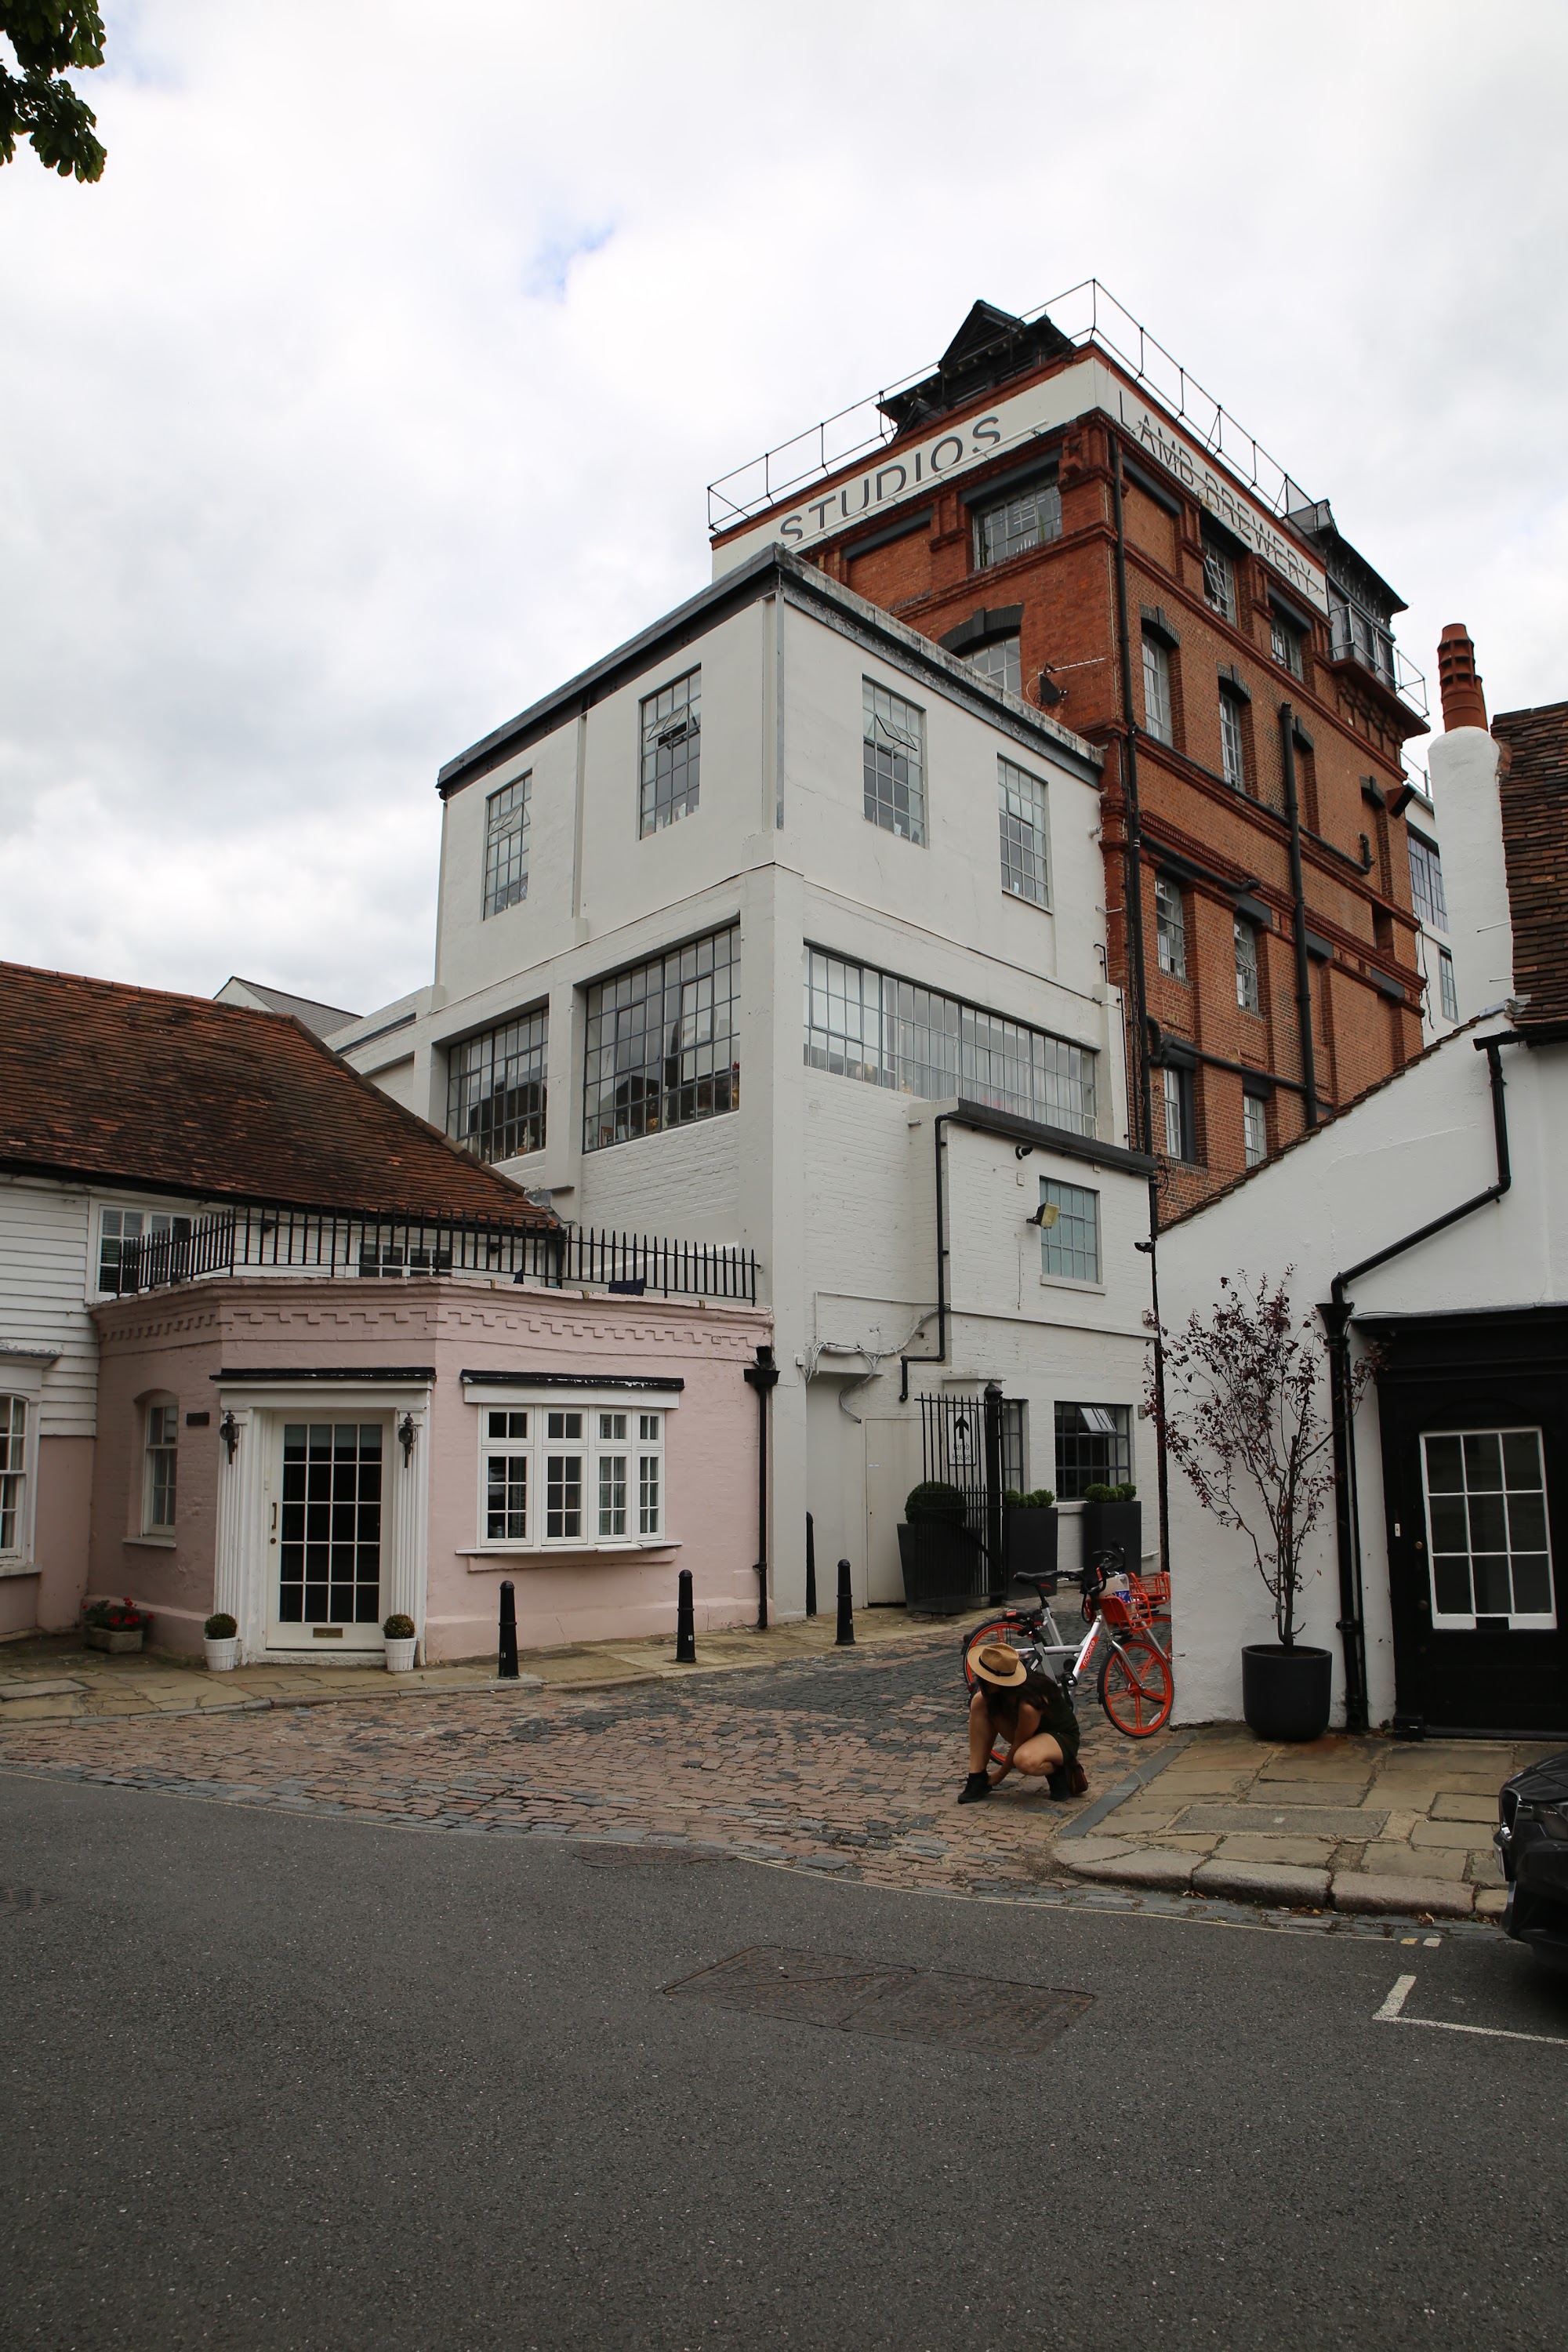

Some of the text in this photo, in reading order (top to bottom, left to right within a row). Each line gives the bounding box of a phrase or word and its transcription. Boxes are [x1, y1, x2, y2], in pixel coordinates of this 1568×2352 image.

[779, 416, 1001, 545] STUDIOS
[1119, 390, 1311, 593] LAMB BREWERY
[1082, 1639, 1096, 1667] mobike
